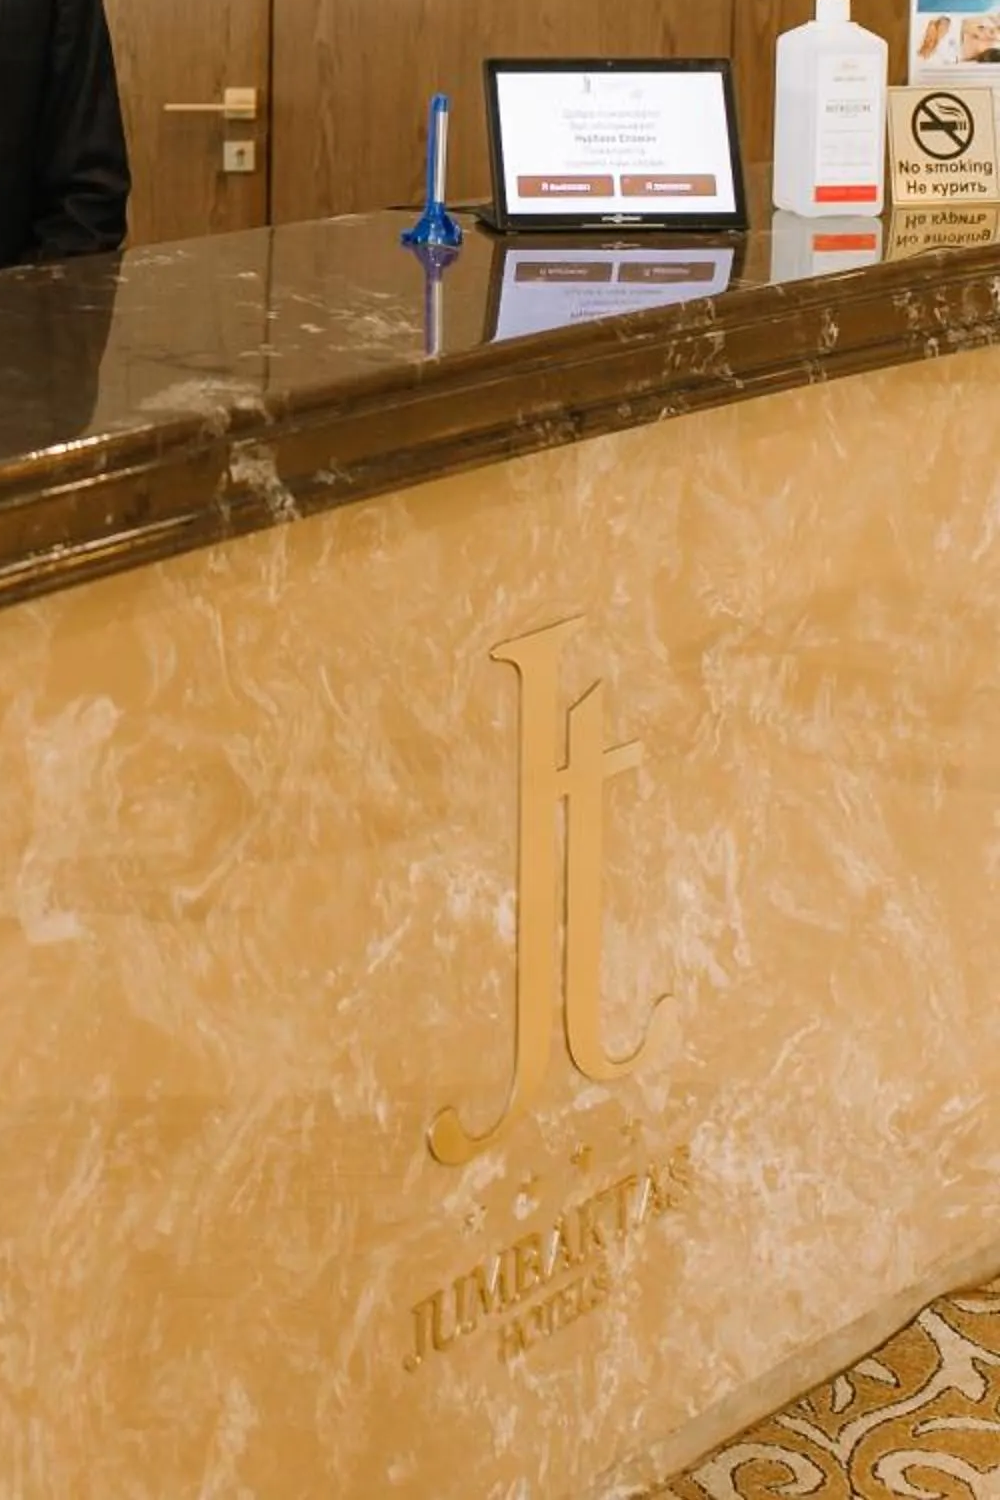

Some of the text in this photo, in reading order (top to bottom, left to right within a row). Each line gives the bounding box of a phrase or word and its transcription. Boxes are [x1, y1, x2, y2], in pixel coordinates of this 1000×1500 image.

[898, 159, 993, 176] No smoking
[907, 180, 987, 197] Не курить
